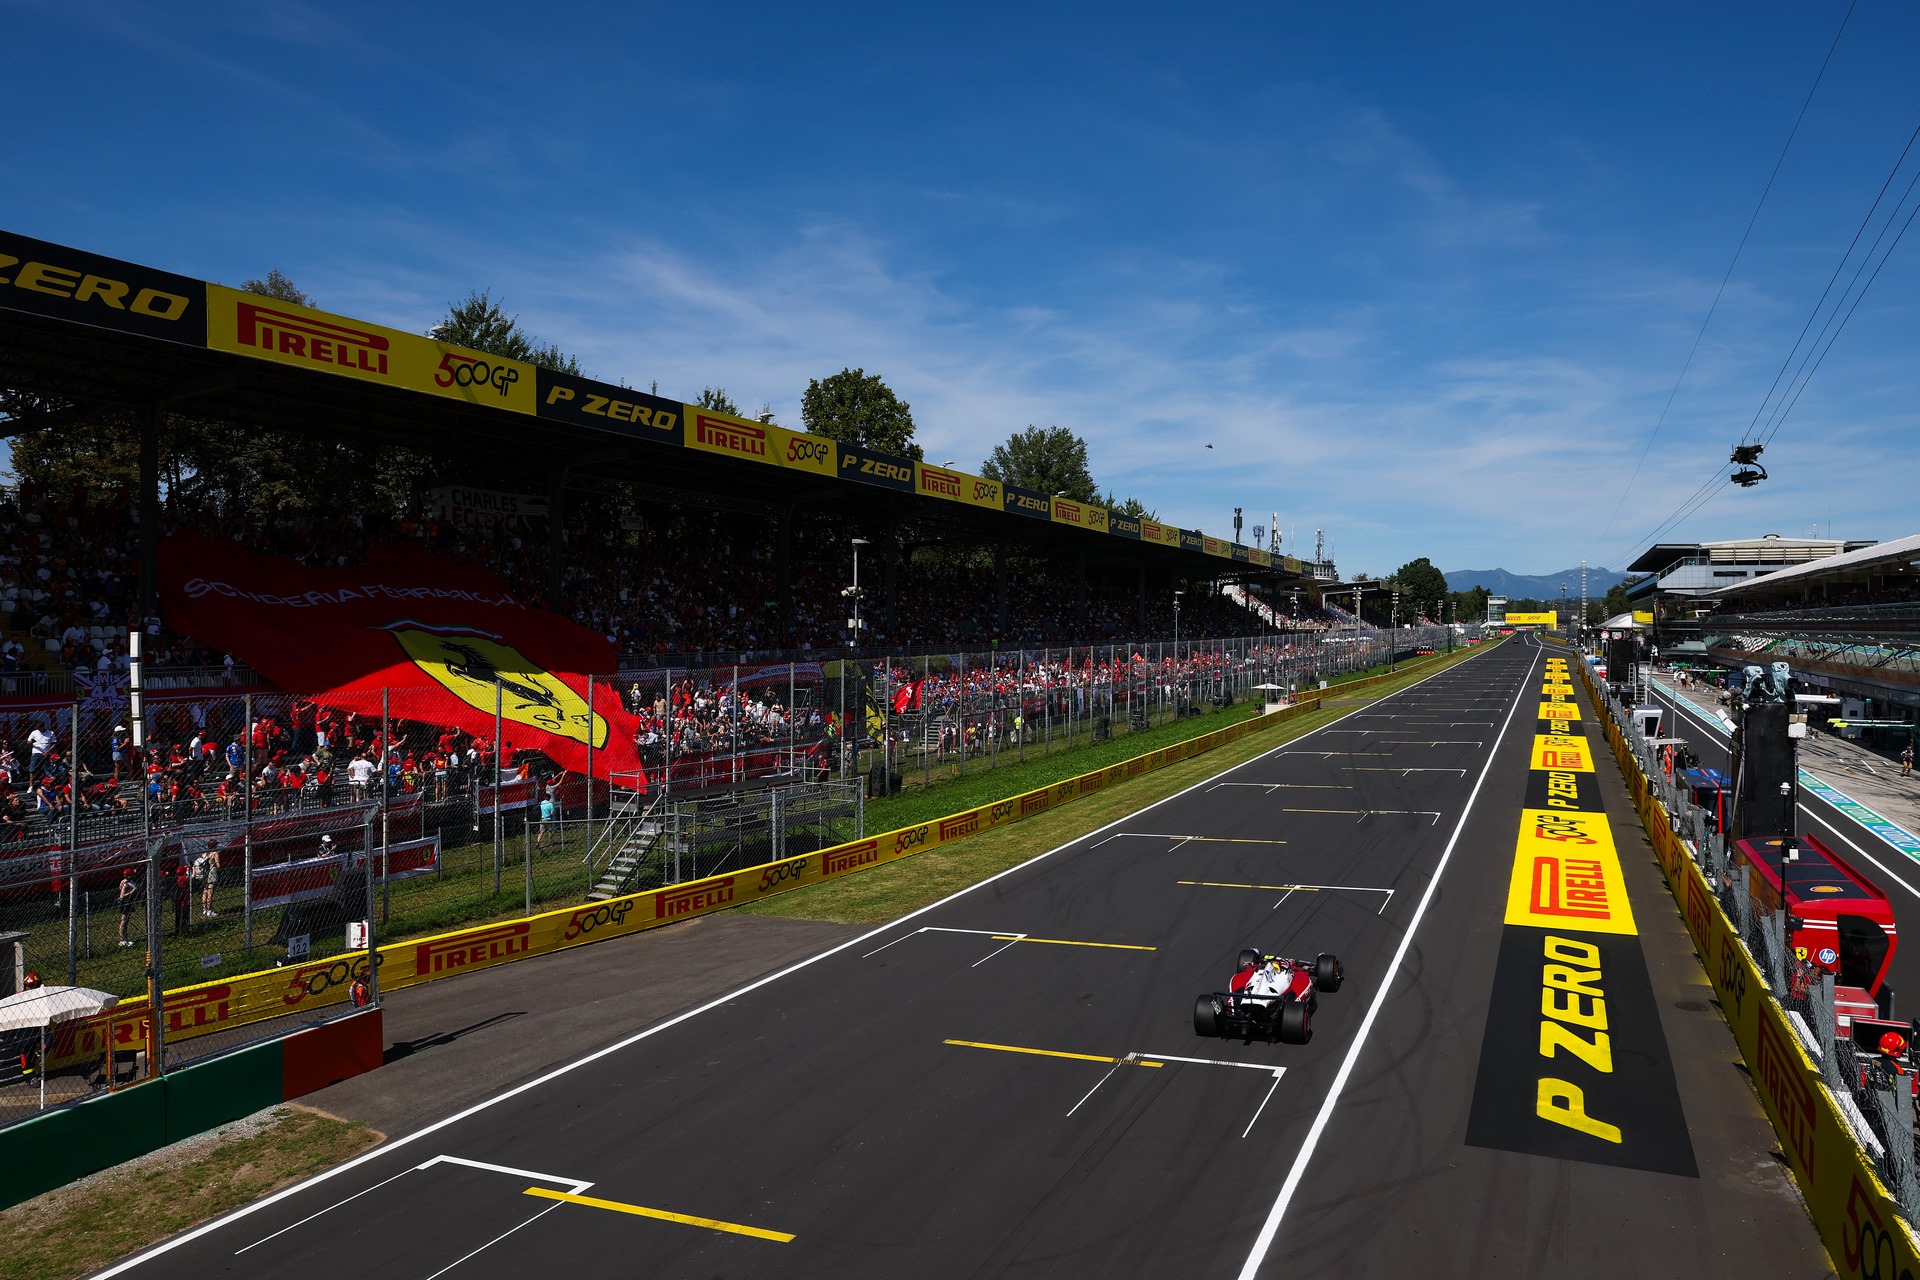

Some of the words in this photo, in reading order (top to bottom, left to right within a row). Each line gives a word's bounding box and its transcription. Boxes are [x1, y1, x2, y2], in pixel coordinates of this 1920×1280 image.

[236, 301, 390, 375] PIRELLI
[434, 352, 519, 397] 500GP
[546, 385, 575, 405] P
[581, 393, 677, 431] ZERO
[696, 414, 766, 456] PIRELLI
[787, 437, 829, 465] 500GP
[842, 454, 857, 469] P
[860, 458, 912, 482] ZERO
[921, 468, 961, 497] PIRELLI
[452, 489, 517, 512] CHARLES
[1006, 492, 1016, 504] P
[1017, 495, 1049, 513] ZERO
[1055, 500, 1081, 523] PIRELLI
[1110, 518, 1116, 528] P
[1117, 520, 1139, 533] ZERO
[1143, 523, 1161, 540] PIRELLI
[1186, 536, 1202, 547] ZERO
[91, 685, 119, 700] 44
[1127, 757, 1145, 777] PIRELLI
[1542, 750, 1583, 769] PIRELLI
[1080, 773, 1103, 793] PIRELLI
[1547, 771, 1579, 799] ZERO
[1020, 789, 1049, 815] PIRELLI
[1547, 798, 1580, 810] P
[894, 826, 929, 855] 500GP
[939, 812, 979, 842] PIRELLI
[1535, 814, 1598, 845] 500GP
[758, 858, 807, 893] 500GP
[822, 840, 879, 876] PIRELLI
[1529, 856, 1611, 920] PIRELLI
[564, 900, 634, 941] 500GP
[655, 877, 735, 920] PIRELLI
[1687, 868, 1712, 960] PIRELLI
[292, 943, 307, 955] 12.2
[1821, 950, 1836, 964] hp
[52, 985, 232, 1060] PIRLLI
[416, 922, 531, 976] PIRELLI
[1540, 935, 1614, 1073] ZERO
[1757, 1000, 1817, 1187] PIRELLI
[1536, 1077, 1623, 1144] P
